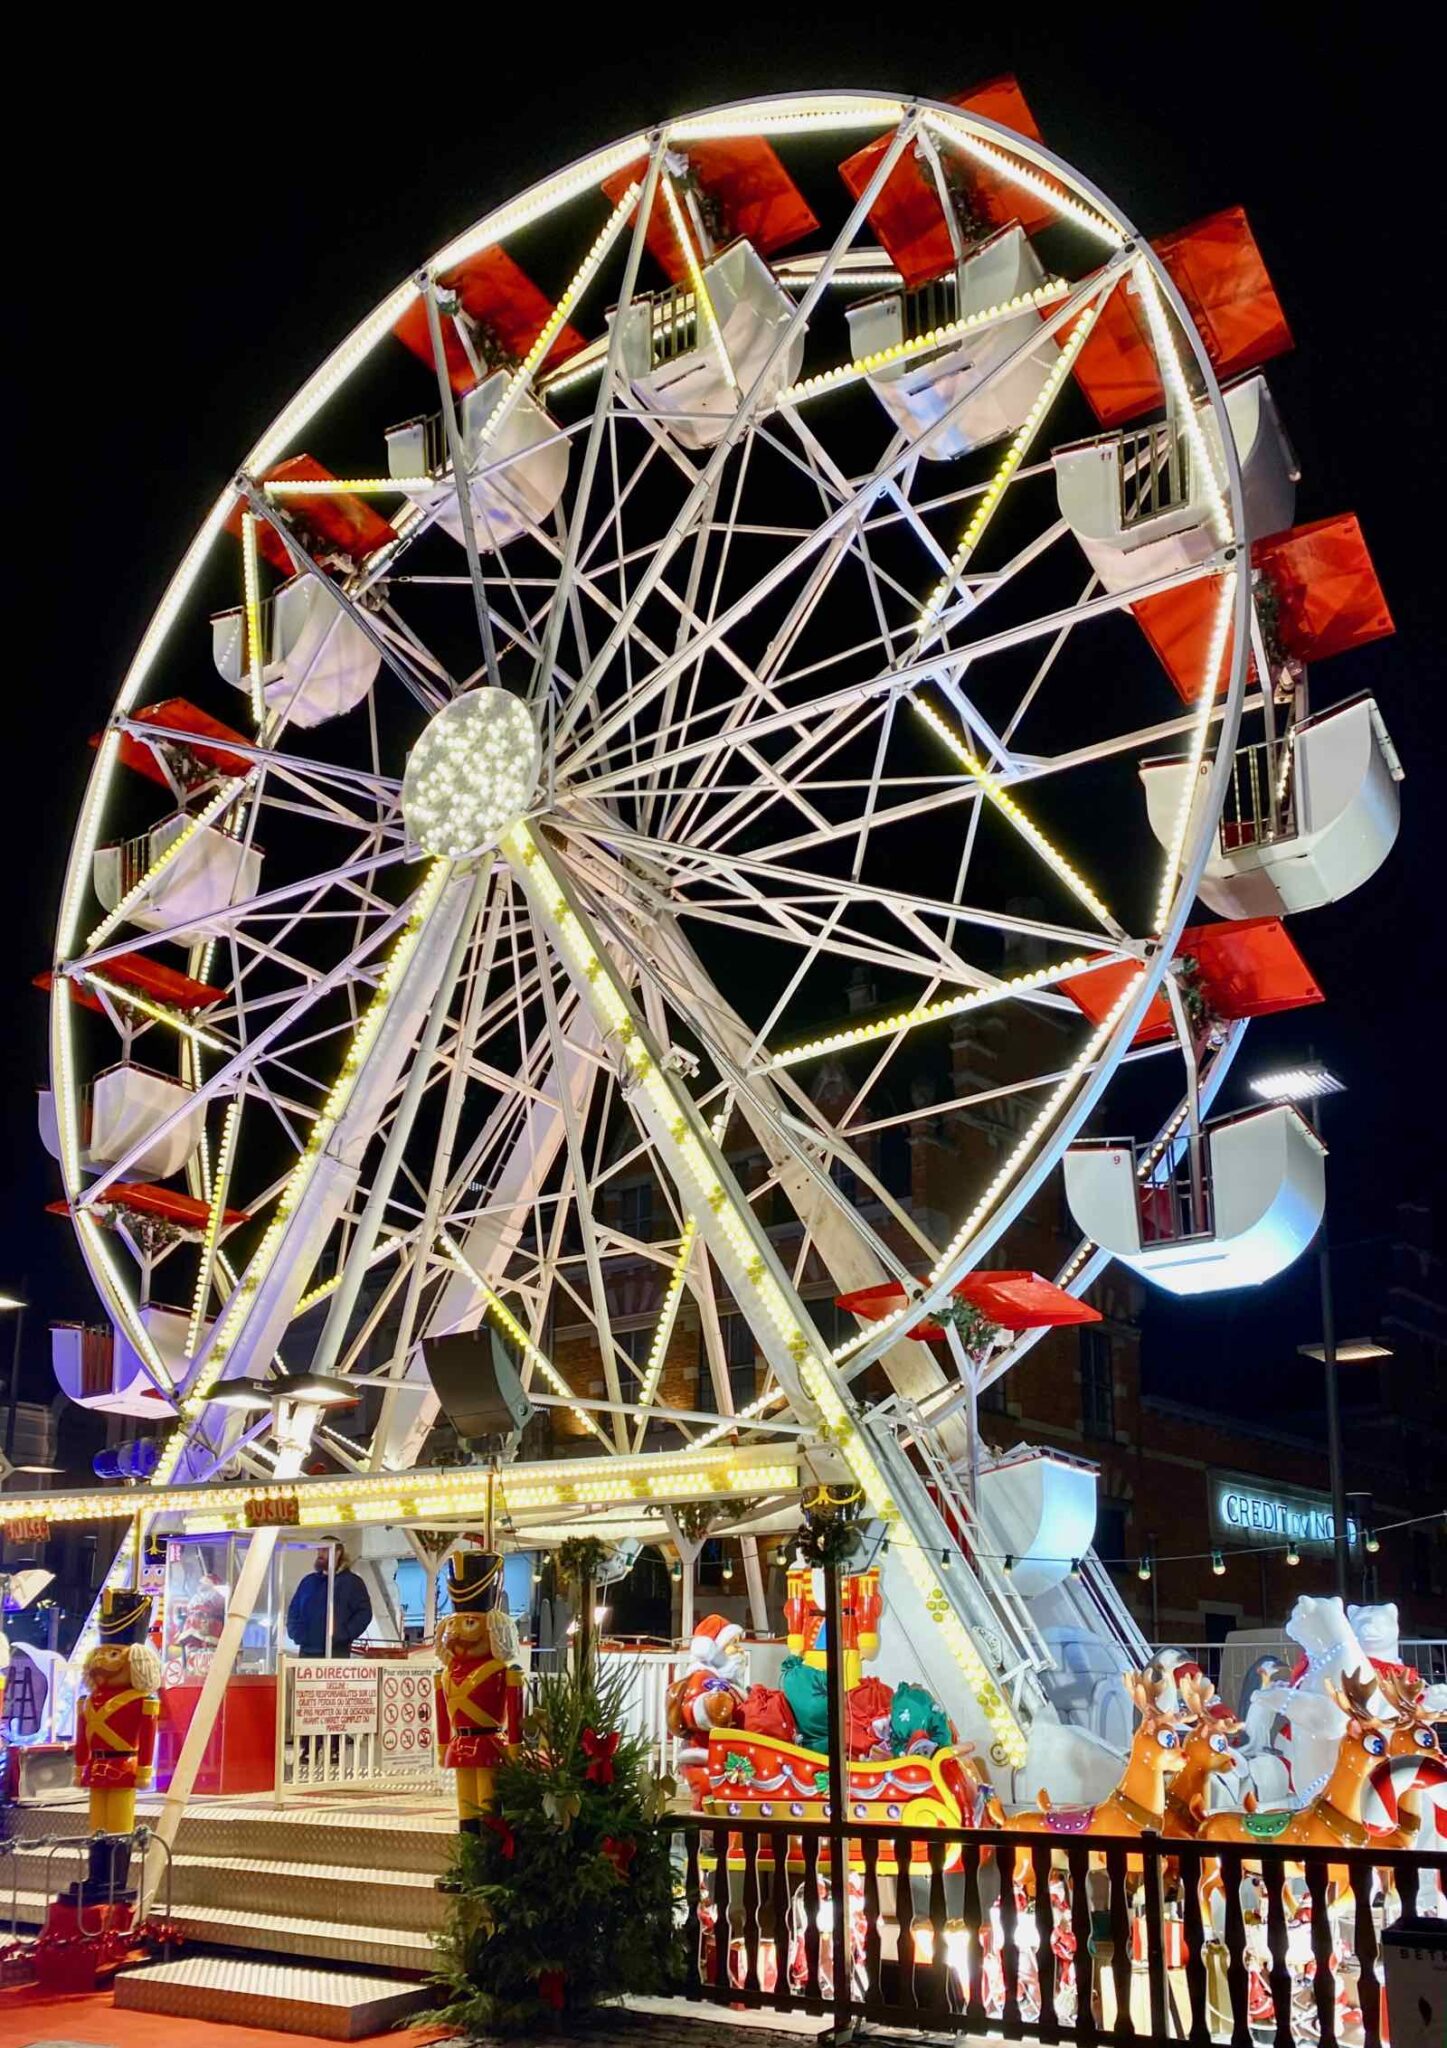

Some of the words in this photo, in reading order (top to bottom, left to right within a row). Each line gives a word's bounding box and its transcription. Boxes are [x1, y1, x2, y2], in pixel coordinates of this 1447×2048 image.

[1113, 1155, 1121, 1165] 9
[1315, 1511, 1357, 1545] NOD
[297, 1667, 312, 1679] LA
[315, 1667, 377, 1679] DIRECTION
